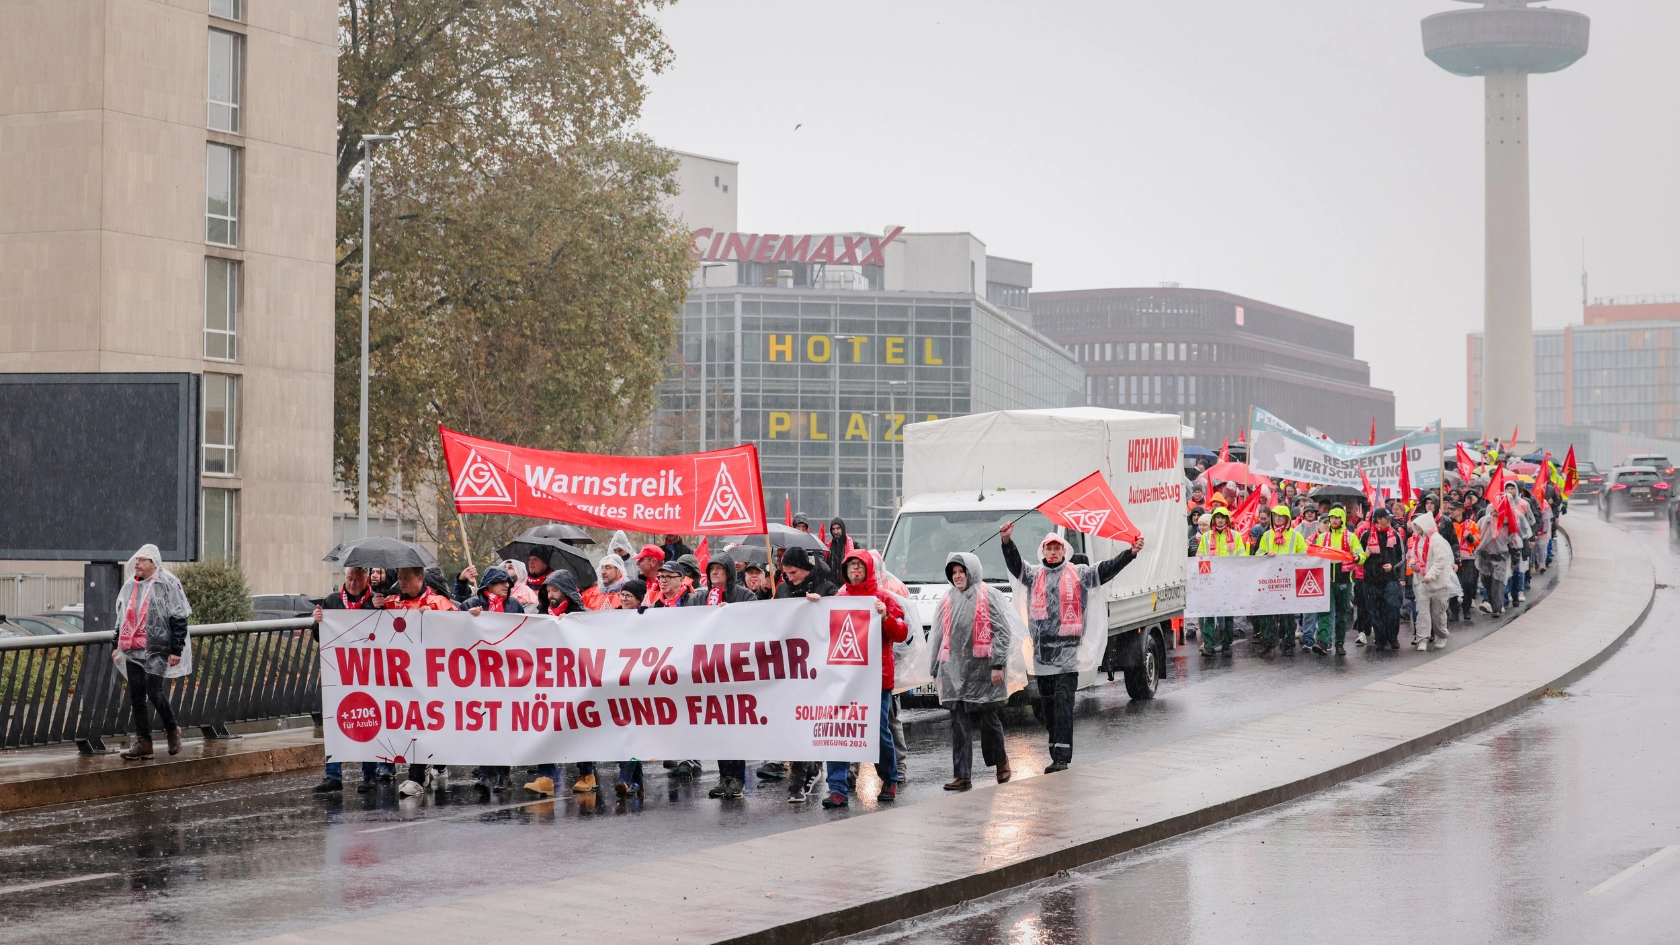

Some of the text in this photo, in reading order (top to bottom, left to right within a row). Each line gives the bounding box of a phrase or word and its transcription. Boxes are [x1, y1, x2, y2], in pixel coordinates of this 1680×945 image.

[690, 226, 905, 267] CINEMAXX
[769, 334, 942, 365] HOTEL
[769, 411, 938, 440] PLAZ
[1128, 436, 1178, 473] HOFFMANN
[1323, 453, 1387, 470] RESPEKT
[524, 464, 683, 497] Warnstreik
[633, 502, 681, 520] Recht
[335, 638, 817, 688] WIR FORDERN 7% MEHR.
[343, 719, 379, 730] für Azubis
[350, 707, 376, 719] 170€
[385, 693, 768, 732] DAS IST NÖTIG UND FAIR.
[795, 702, 868, 721] SOLIDARITÄT
[813, 722, 867, 738] GEWINNT
